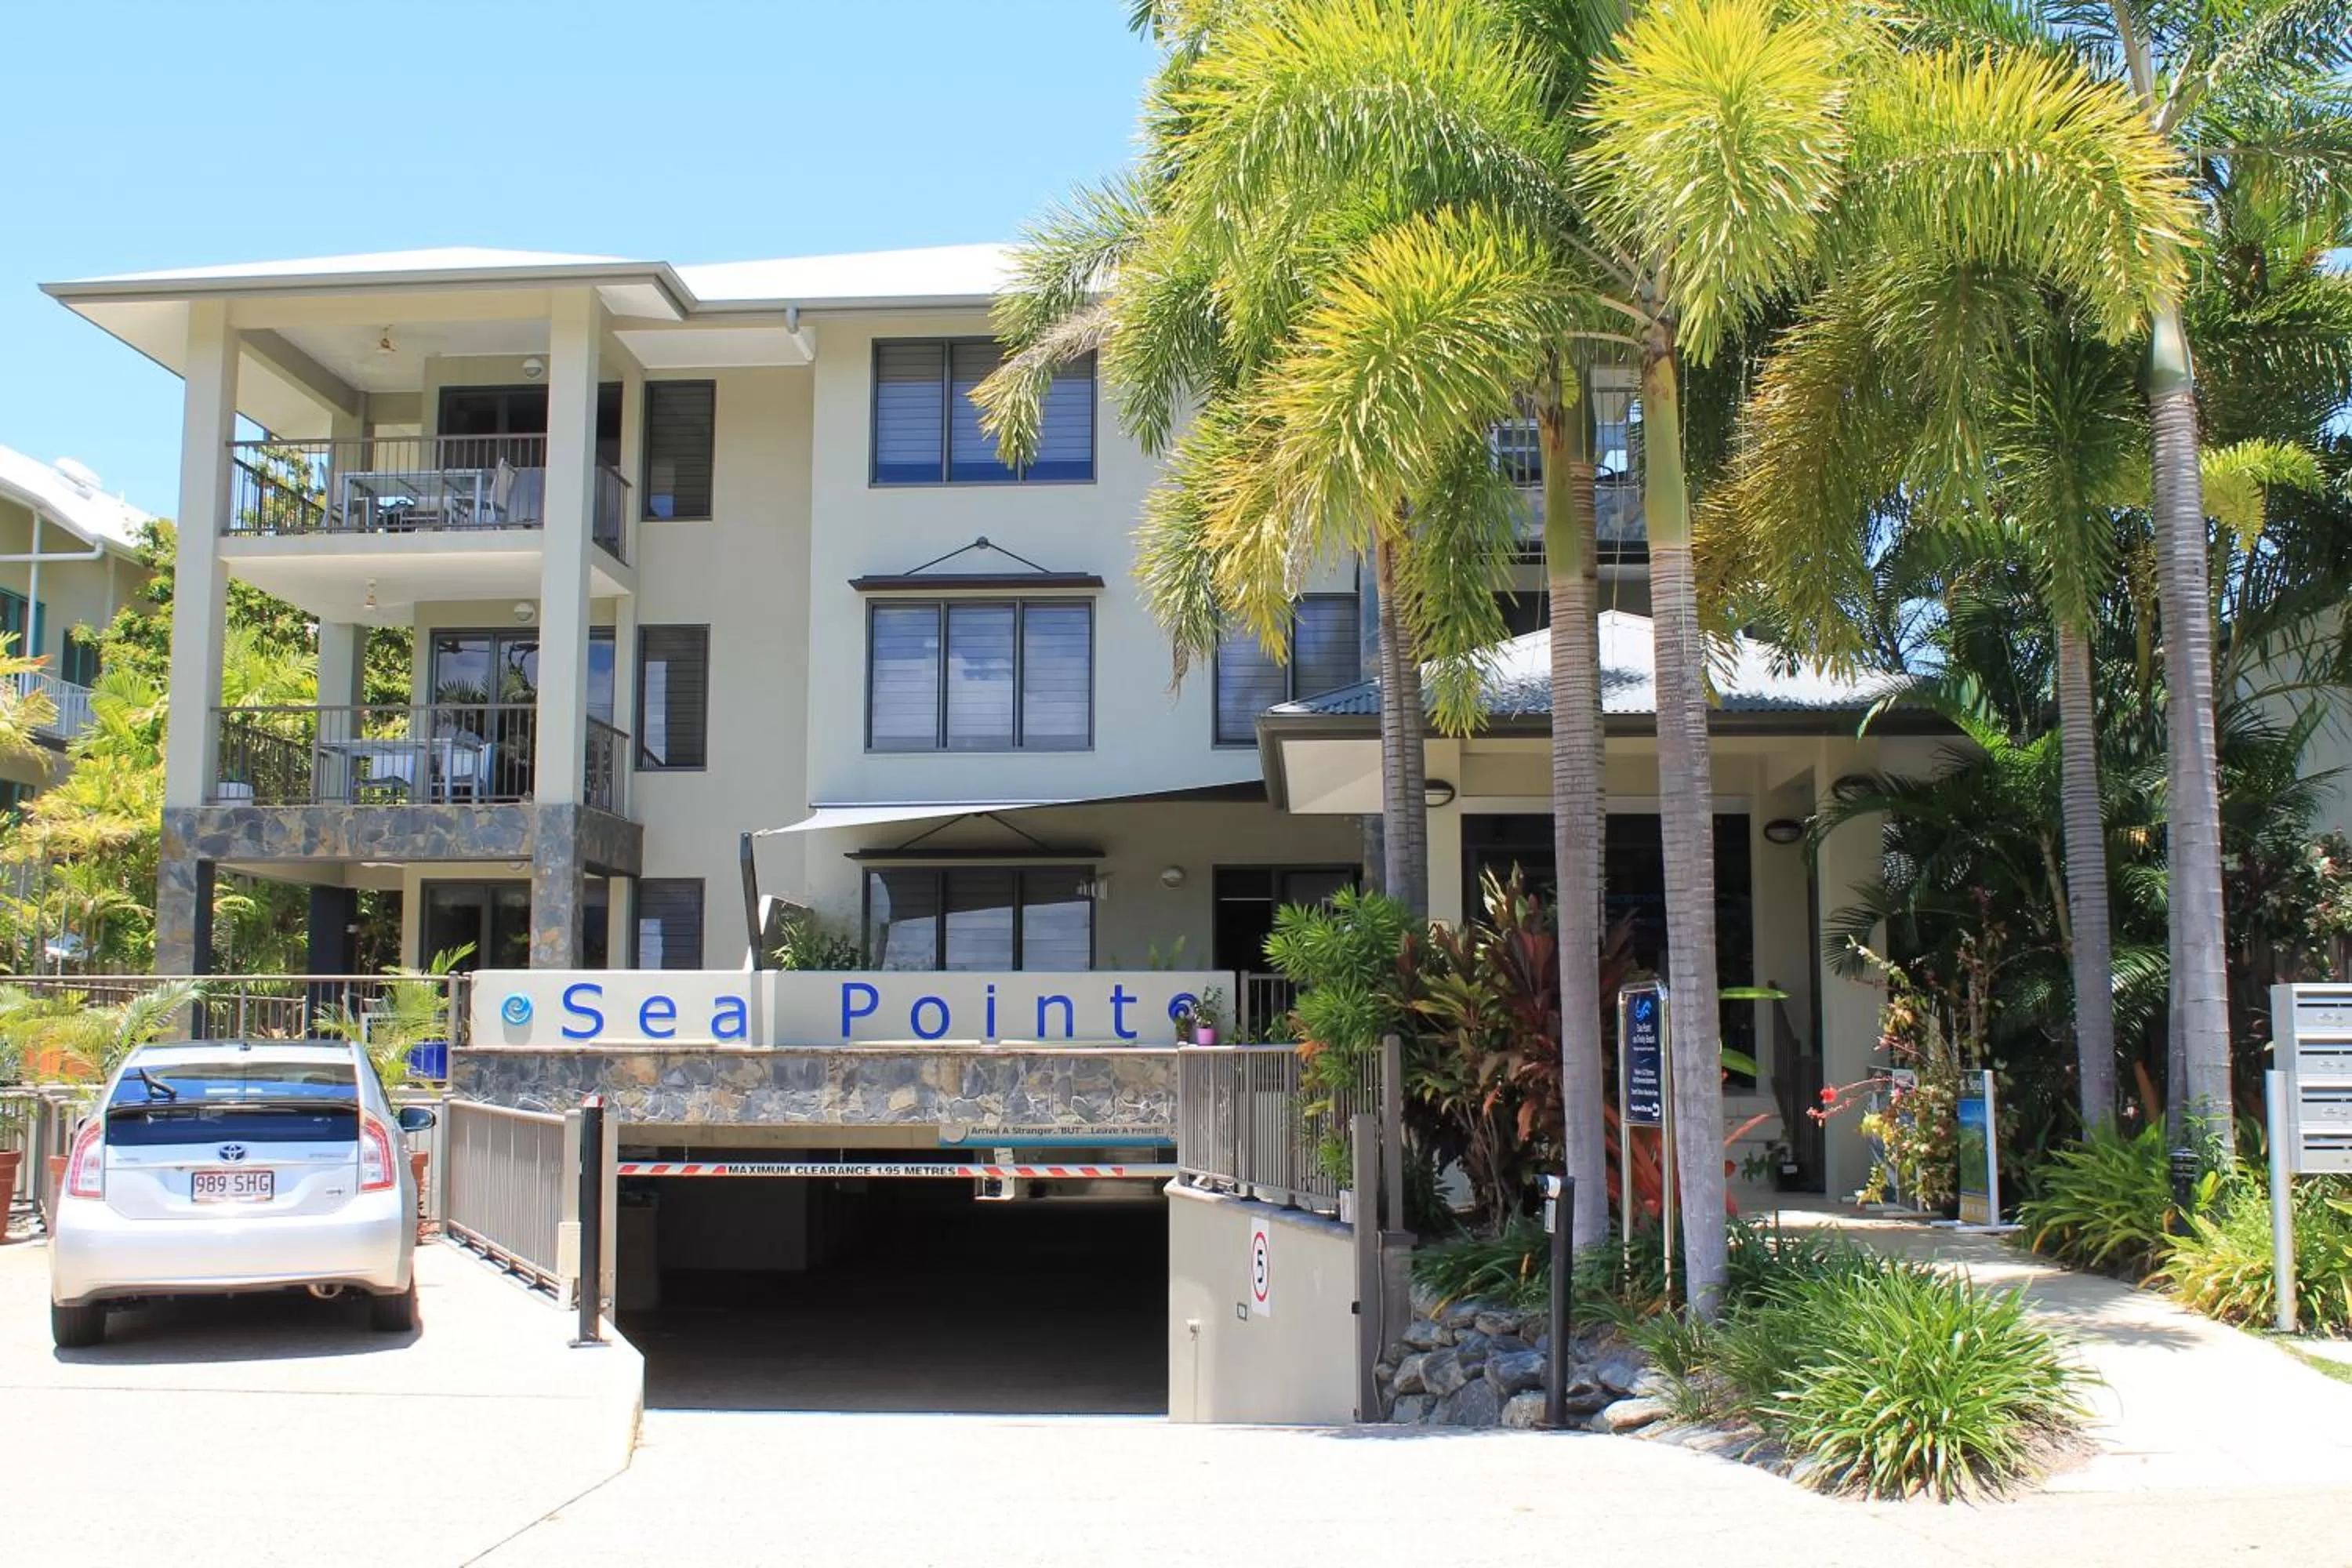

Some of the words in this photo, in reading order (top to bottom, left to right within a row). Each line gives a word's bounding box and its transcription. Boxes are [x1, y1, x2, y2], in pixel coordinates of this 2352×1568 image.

[561, 982, 747, 1040] Sea
[728, 1165, 791, 1174] MAXIMUM
[794, 1166, 872, 1175] CLEARANCE
[876, 1166, 900, 1175] 1.95
[904, 1166, 956, 1176] METRES
[196, 1176, 227, 1192] 989
[1257, 1249, 1265, 1283] 5
